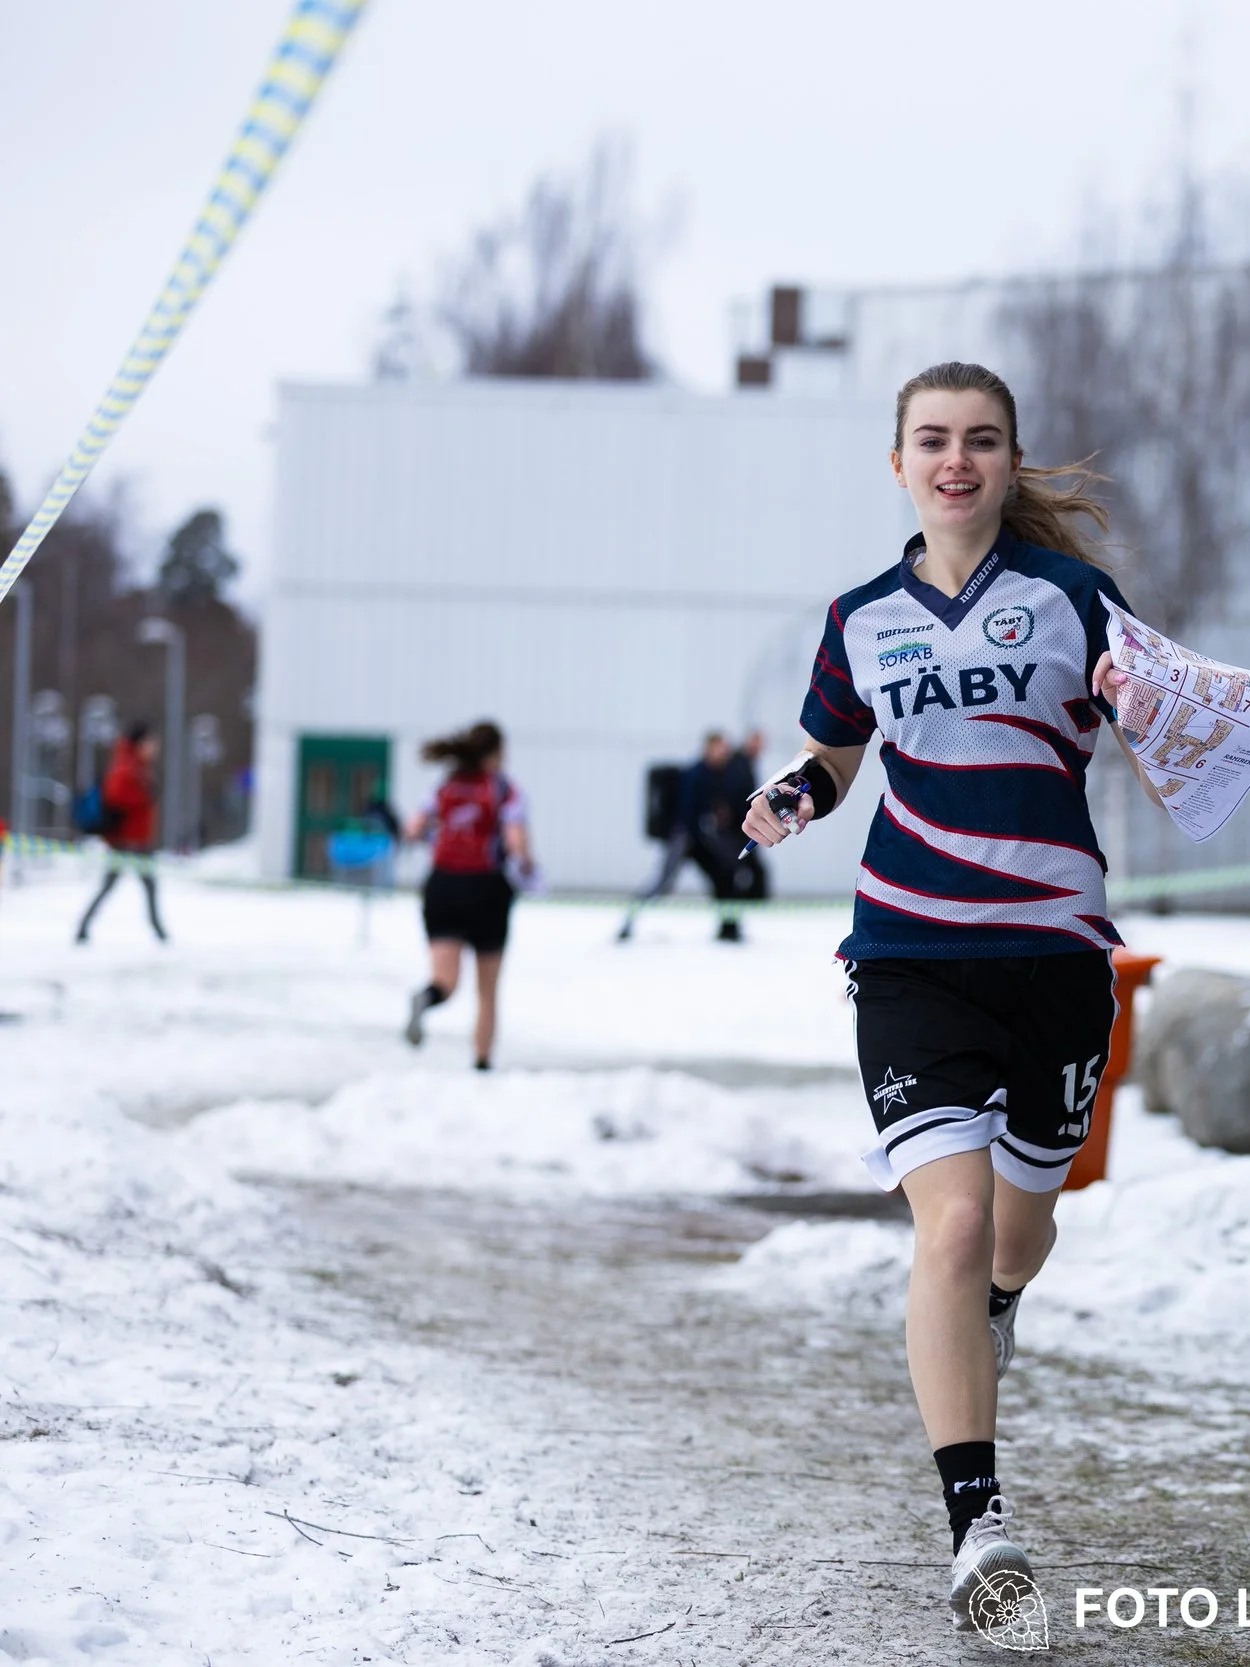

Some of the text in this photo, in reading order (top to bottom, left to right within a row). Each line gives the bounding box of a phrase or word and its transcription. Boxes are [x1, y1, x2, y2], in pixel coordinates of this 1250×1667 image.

[959, 552, 1000, 604] noname
[993, 615, 1024, 627] TÄBY
[876, 623, 934, 640] noname
[879, 647, 933, 671] SORAB
[1170, 669, 1180, 682] 3
[880, 663, 1038, 720] TÄBY
[1195, 759, 1206, 769] 6
[1062, 1054, 1100, 1113] 15
